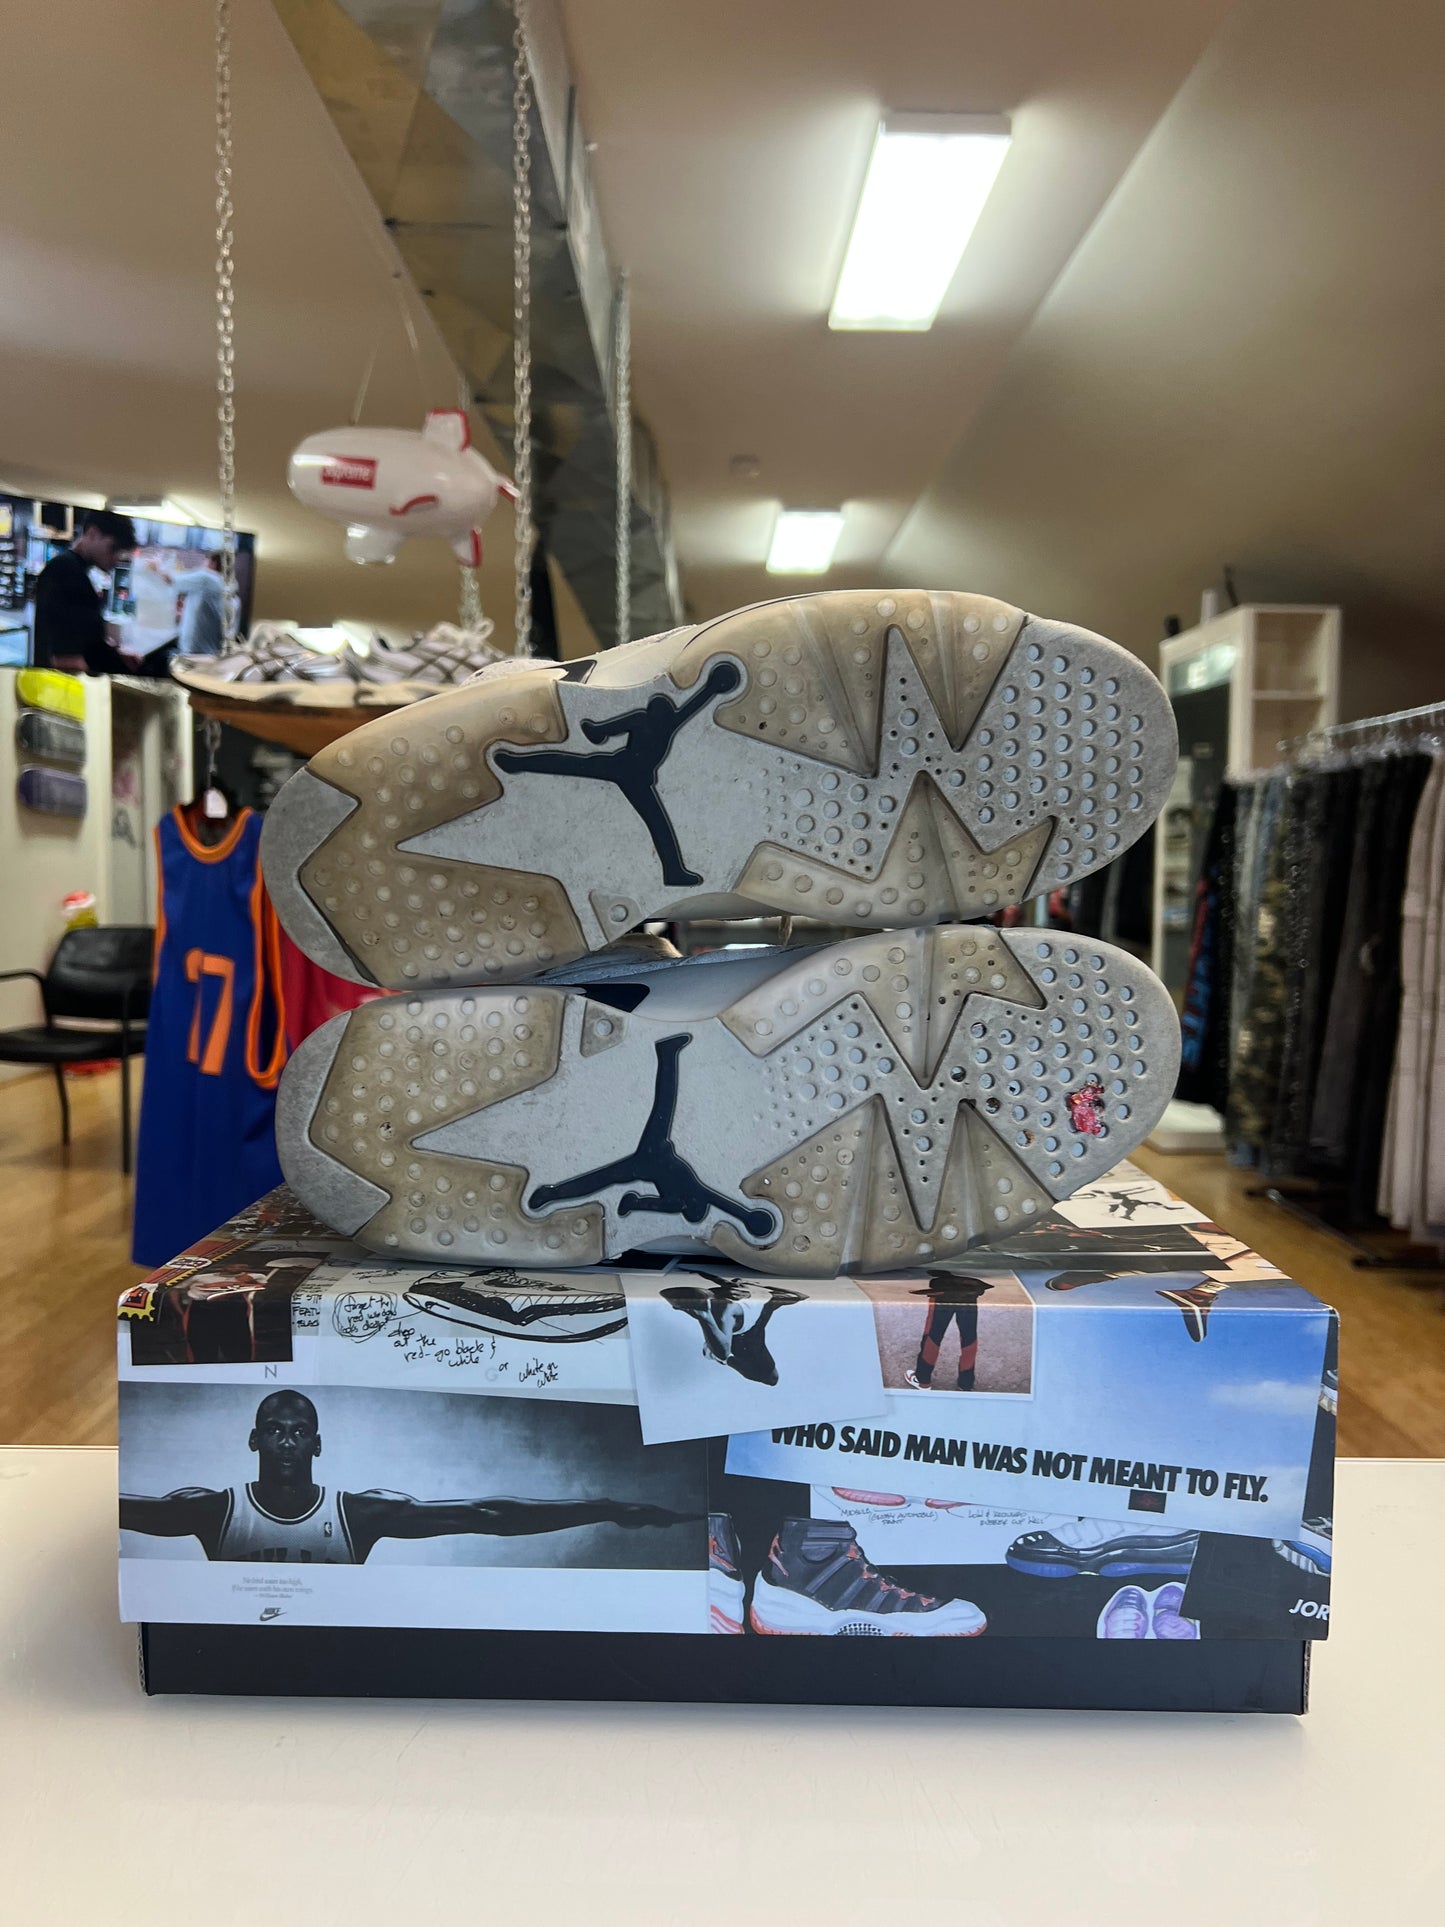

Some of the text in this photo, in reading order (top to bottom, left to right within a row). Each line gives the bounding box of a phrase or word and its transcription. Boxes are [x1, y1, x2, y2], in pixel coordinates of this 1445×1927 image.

[434, 1348, 451, 1363] go
[264, 1364, 278, 1379] N
[498, 1361, 510, 1372] or
[771, 1423, 1269, 1503] WHO SAID MAN WAS NOT MEANT TO FLY.
